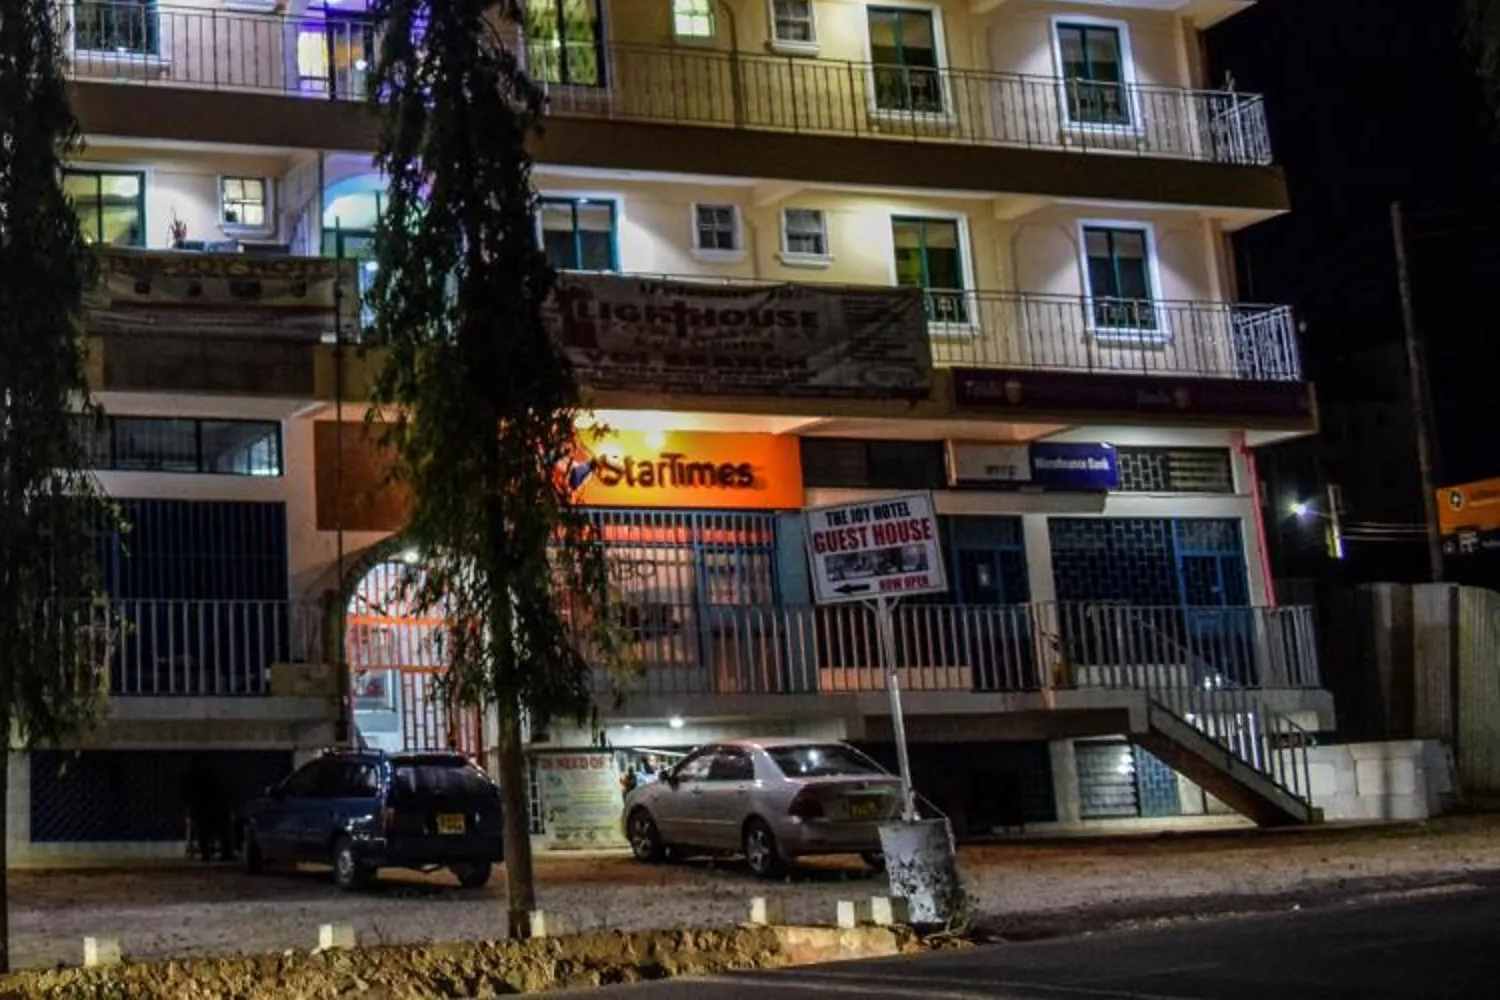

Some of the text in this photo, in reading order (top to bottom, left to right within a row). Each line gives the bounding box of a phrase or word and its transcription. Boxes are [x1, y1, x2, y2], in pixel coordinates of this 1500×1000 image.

[597, 453, 755, 488] StarTimes
[826, 510, 848, 527] THE
[873, 502, 911, 520] HOTEL
[813, 518, 932, 554] GUEST HOUSE
